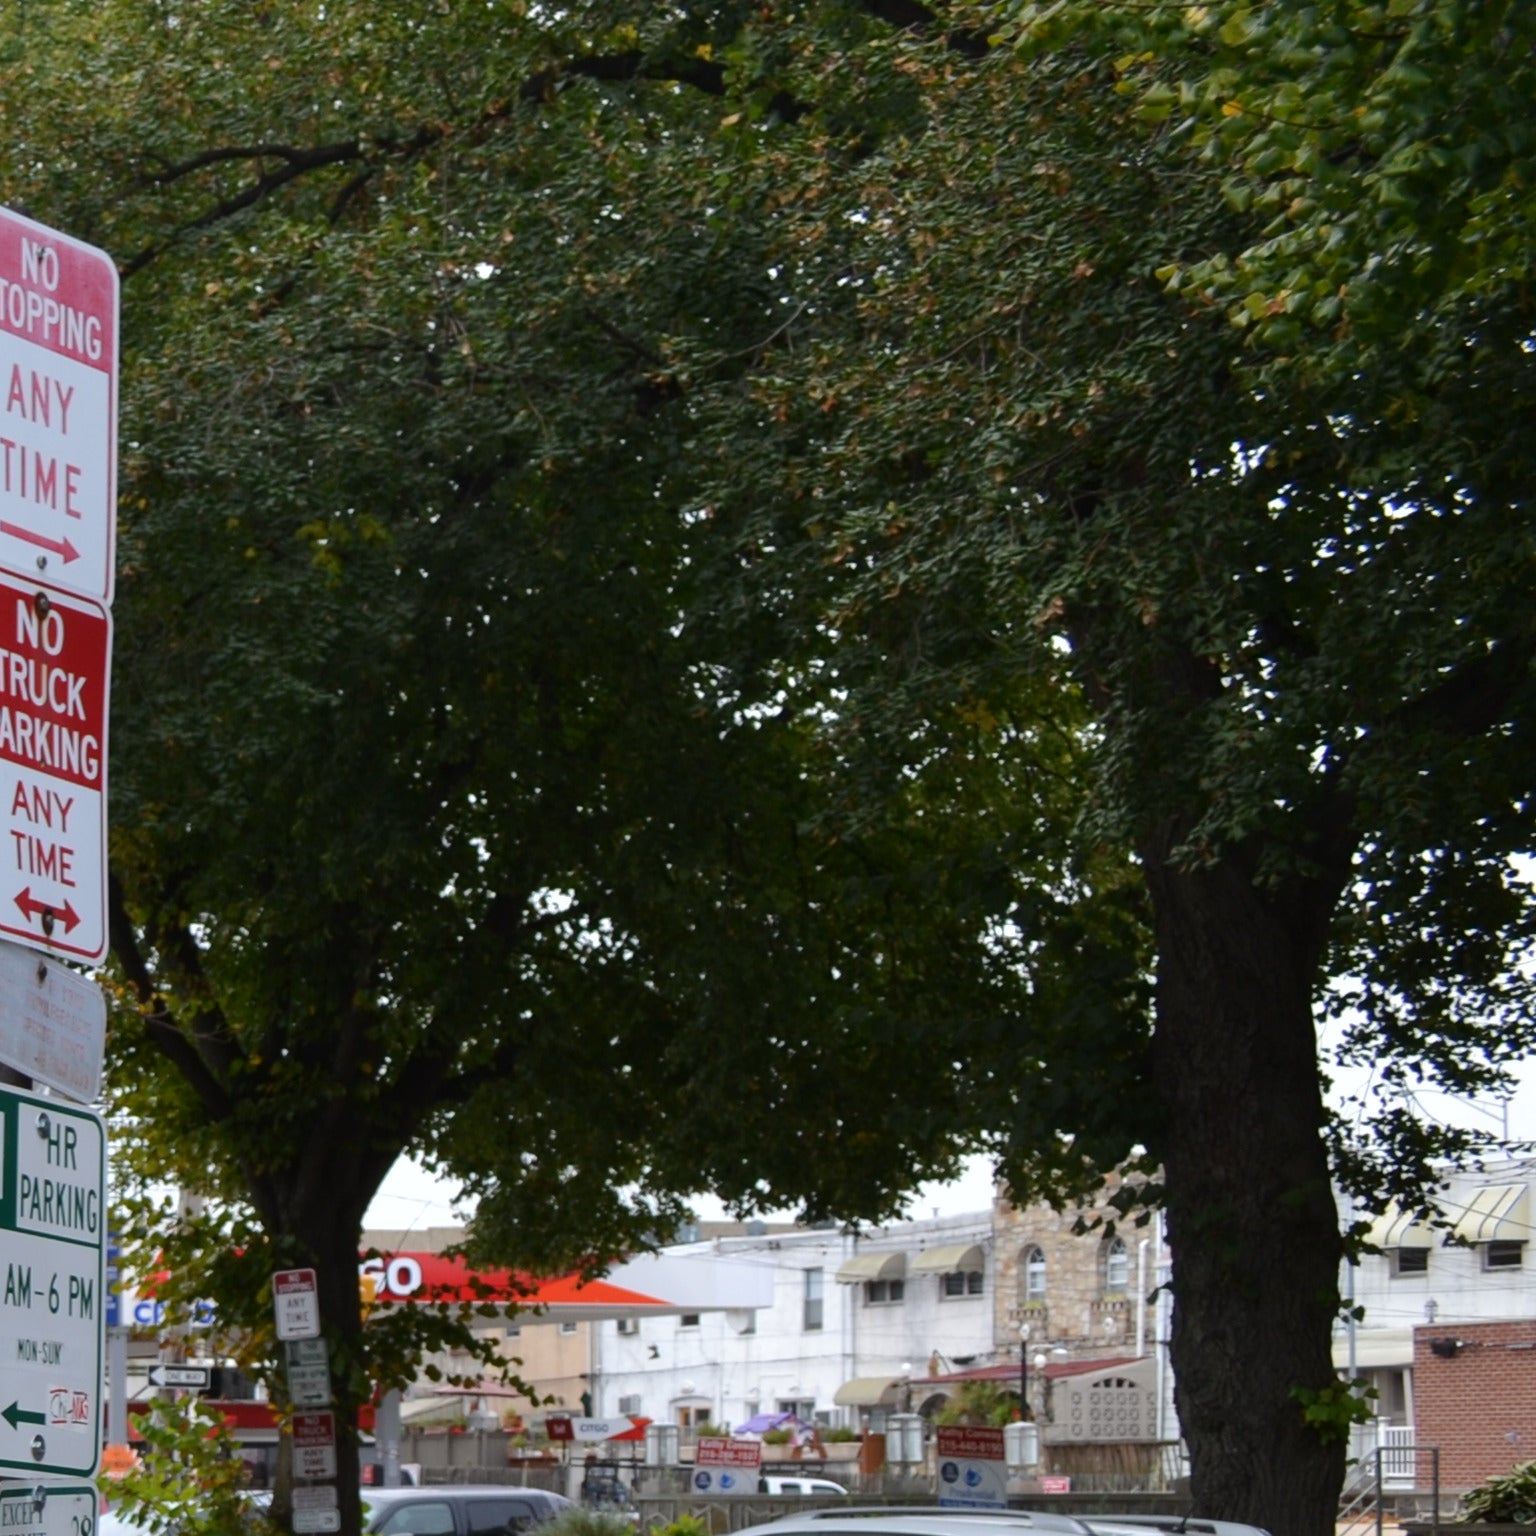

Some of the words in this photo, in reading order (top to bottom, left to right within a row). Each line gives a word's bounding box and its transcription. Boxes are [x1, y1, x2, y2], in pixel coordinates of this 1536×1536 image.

[21, 237, 59, 292] NO
[6, 363, 74, 436] ANY
[0, 437, 82, 520] TIME
[15, 598, 65, 656] NO
[10, 780, 75, 833] ANY
[10, 829, 76, 888] TIME
[46, 1123, 77, 1171] HR
[20, 1173, 98, 1233] PARKING
[68, 1274, 94, 1321] PM
[288, 1273, 300, 1283] NO
[286, 1311, 309, 1322] TIME
[287, 1298, 306, 1307] ANY
[185, 1371, 202, 1382] WAY
[304, 1415, 320, 1425] NO
[580, 1424, 609, 1432] CITGO
[304, 1448, 324, 1457] ANY
[304, 1458, 324, 1467] TIME
